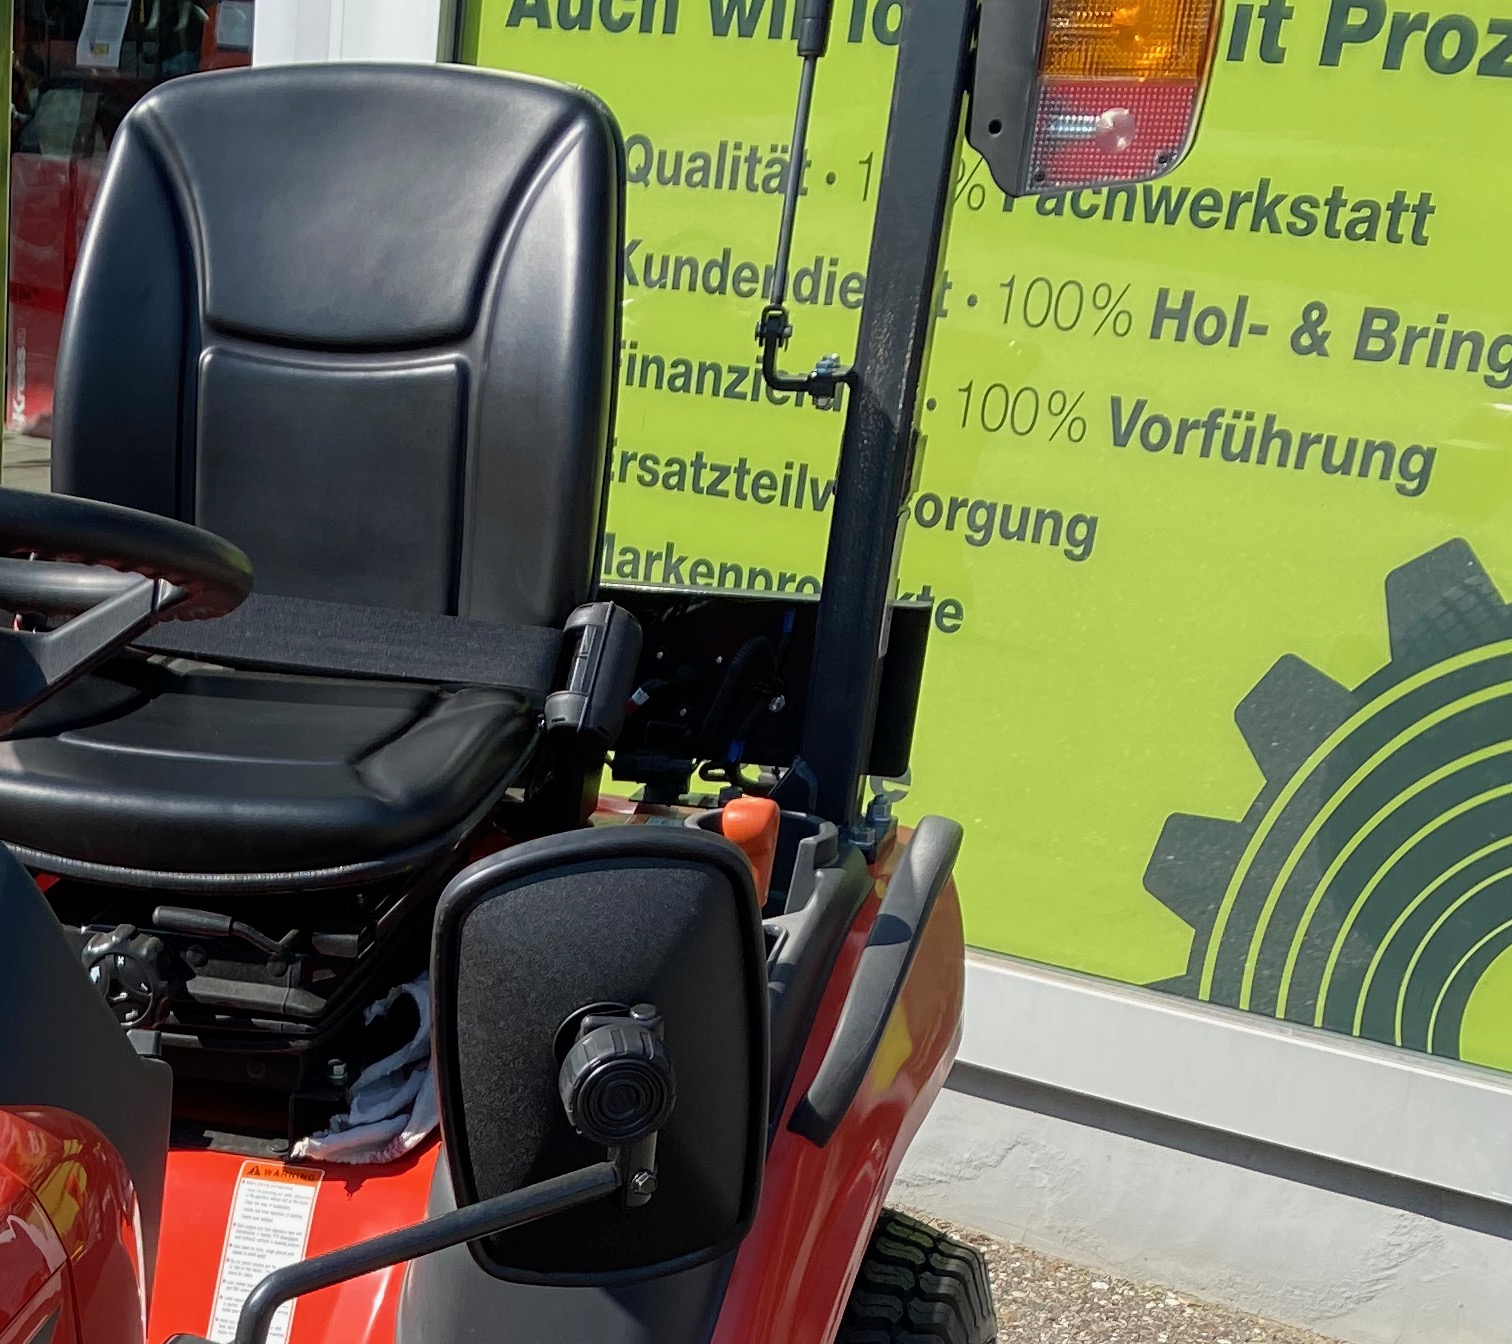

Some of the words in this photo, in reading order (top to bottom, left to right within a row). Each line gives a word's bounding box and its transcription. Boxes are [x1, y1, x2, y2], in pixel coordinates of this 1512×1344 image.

[1225, 0, 1292, 64] it
[626, 134, 811, 197] Qualität
[623, 239, 953, 319] Kundendiet
[999, 274, 1133, 338] 100%
[1149, 286, 1269, 348] Hol-
[1289, 300, 1331, 358] &
[957, 379, 1088, 443] 100%
[1109, 395, 1437, 497] Vorführung
[609, 438, 1099, 562] rsatzteilvorgung
